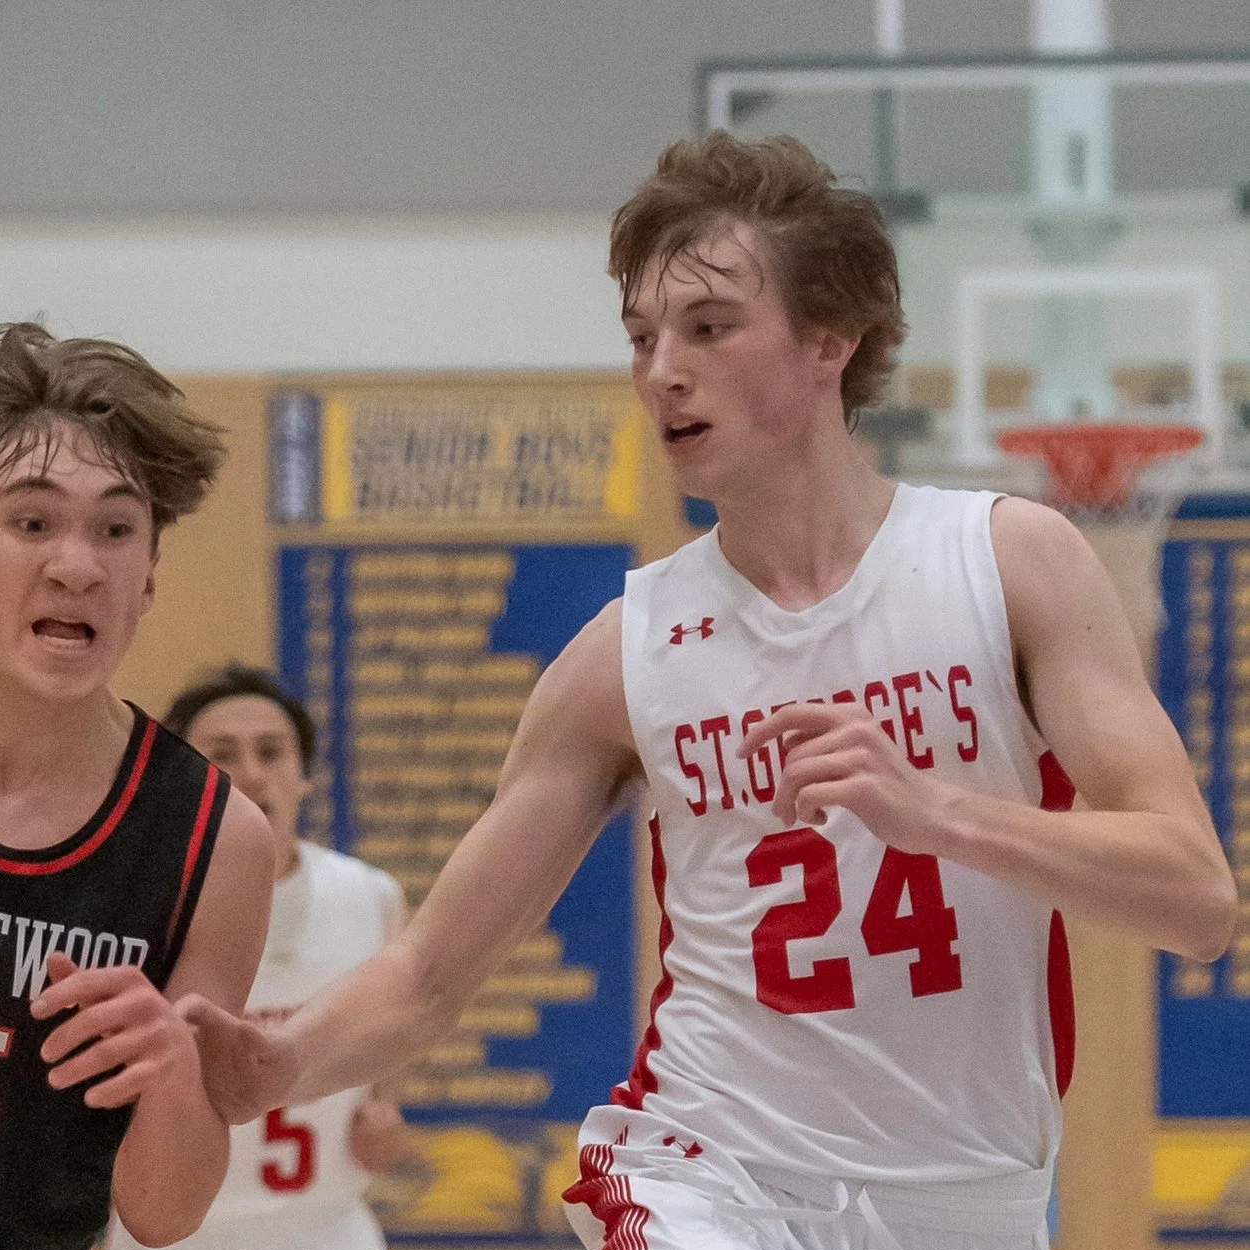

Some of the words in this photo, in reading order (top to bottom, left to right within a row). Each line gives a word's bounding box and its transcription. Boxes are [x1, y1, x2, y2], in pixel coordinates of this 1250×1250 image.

[674, 665, 980, 818] ST.GGE'S
[745, 827, 963, 1017] 24
[261, 1105, 317, 1193] 5
